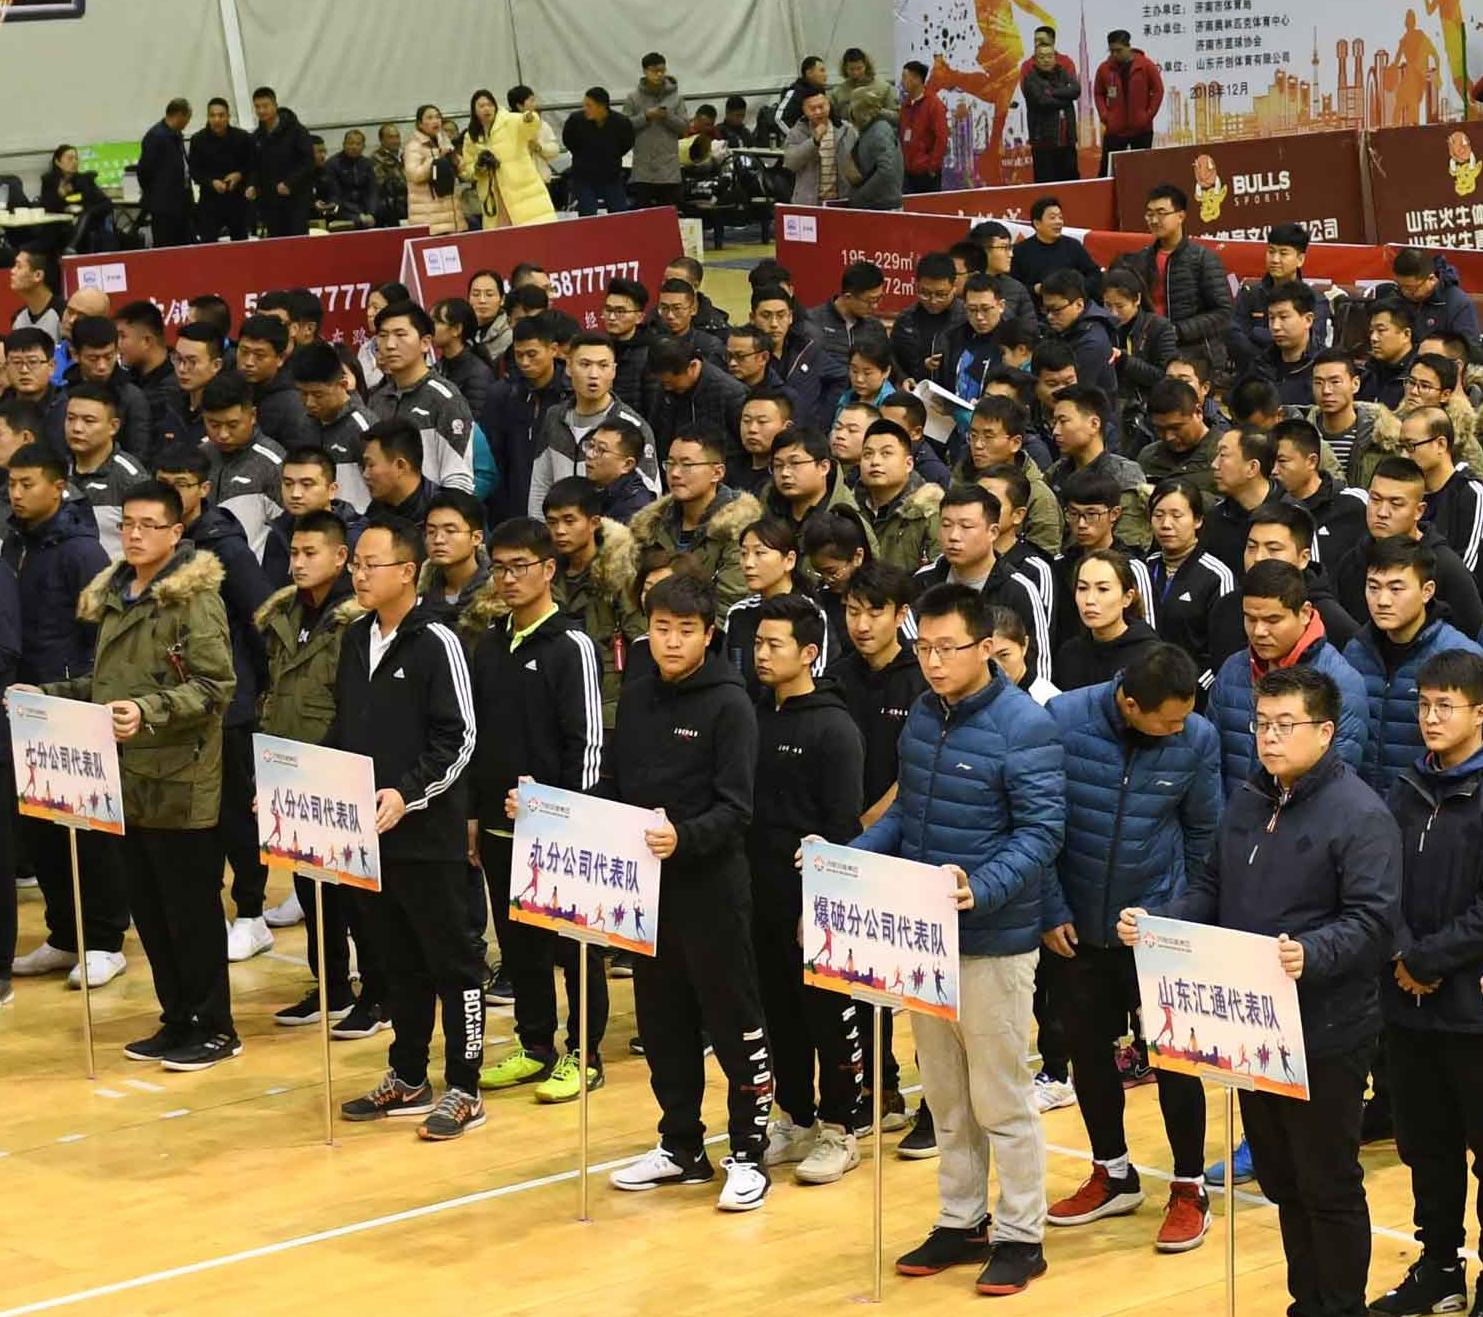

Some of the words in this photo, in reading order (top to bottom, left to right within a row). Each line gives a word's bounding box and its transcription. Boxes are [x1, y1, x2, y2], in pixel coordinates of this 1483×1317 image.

[1232, 171, 1291, 195] BULLS
[1233, 193, 1291, 207] SPORTS
[25, 740, 107, 782] 七分公司代表队
[270, 787, 362, 835] 八分公司代表队
[530, 837, 640, 894] 九分公司代表队
[812, 894, 948, 957] 爆破分公司代表队
[1158, 976, 1280, 1030] 山东汇通代表队
